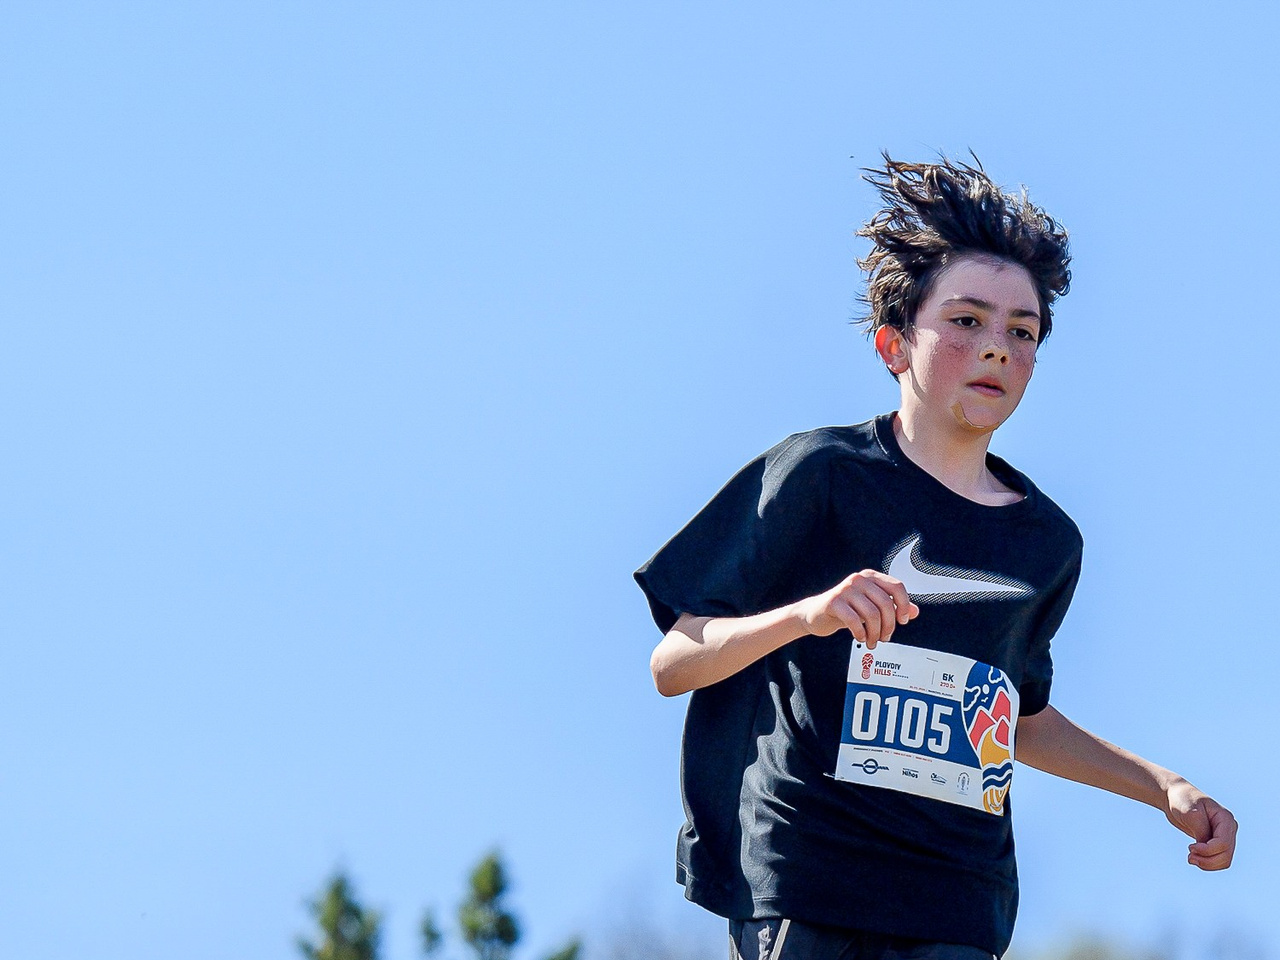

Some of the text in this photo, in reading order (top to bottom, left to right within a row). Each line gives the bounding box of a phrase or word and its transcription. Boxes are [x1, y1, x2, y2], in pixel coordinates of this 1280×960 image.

[875, 661, 901, 670] PLOVDIV
[874, 668, 891, 676] HILLS
[942, 673, 955, 682] 6K
[851, 691, 954, 754] 0105
